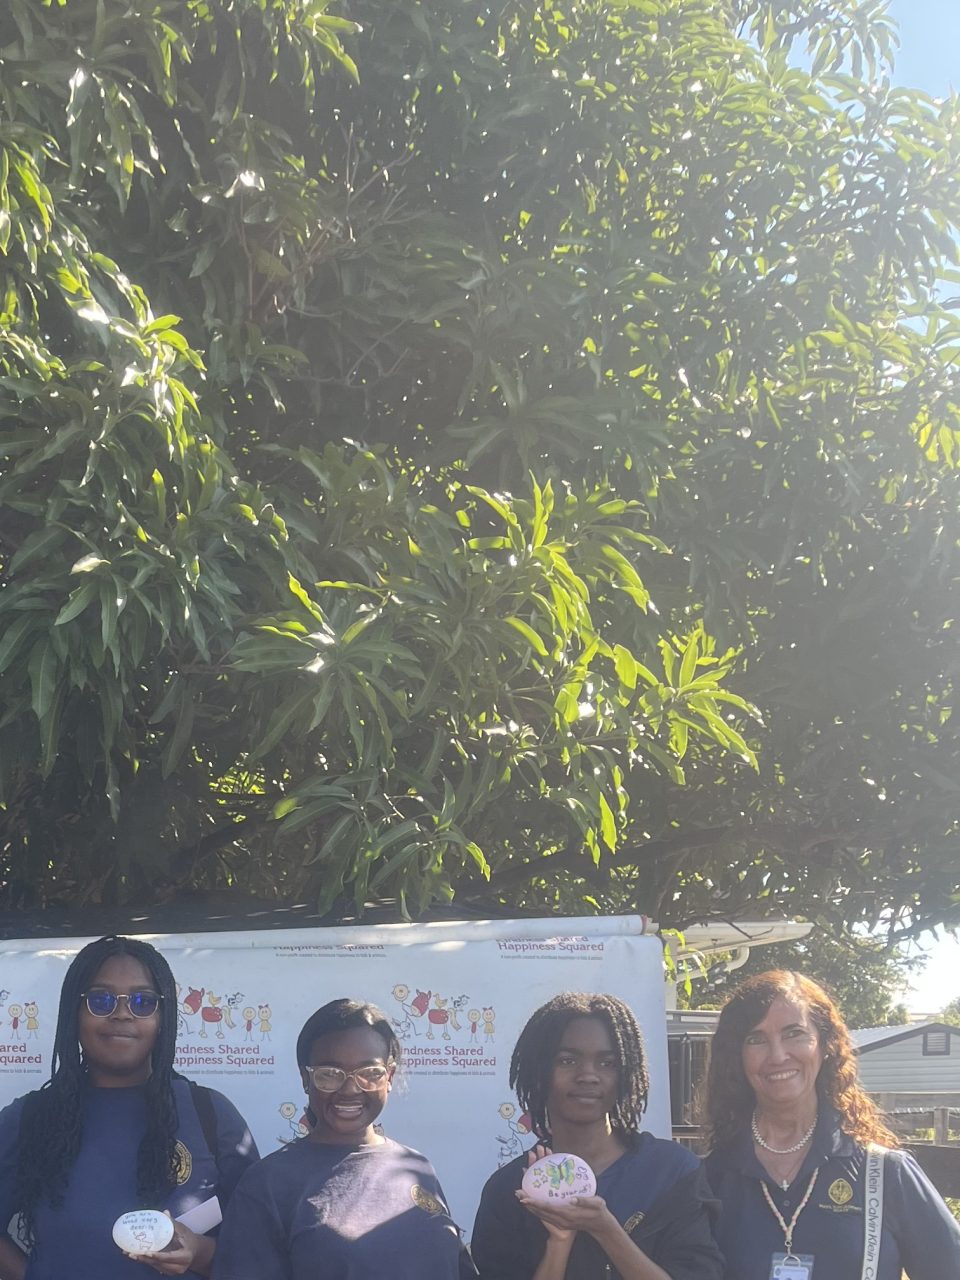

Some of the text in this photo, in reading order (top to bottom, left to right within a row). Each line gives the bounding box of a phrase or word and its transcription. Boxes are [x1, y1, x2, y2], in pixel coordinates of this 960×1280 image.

[498, 942, 604, 952] Happiness Squared
[175, 1044, 260, 1055] ndness Shared
[400, 1046, 484, 1056] indness Shared
[175, 1055, 275, 1067] appiness Squared
[400, 1056, 496, 1069] appiness Squared
[868, 1168, 880, 1194] Klein
[867, 1199, 879, 1232] Calvin
[866, 1232, 877, 1262] Klein
